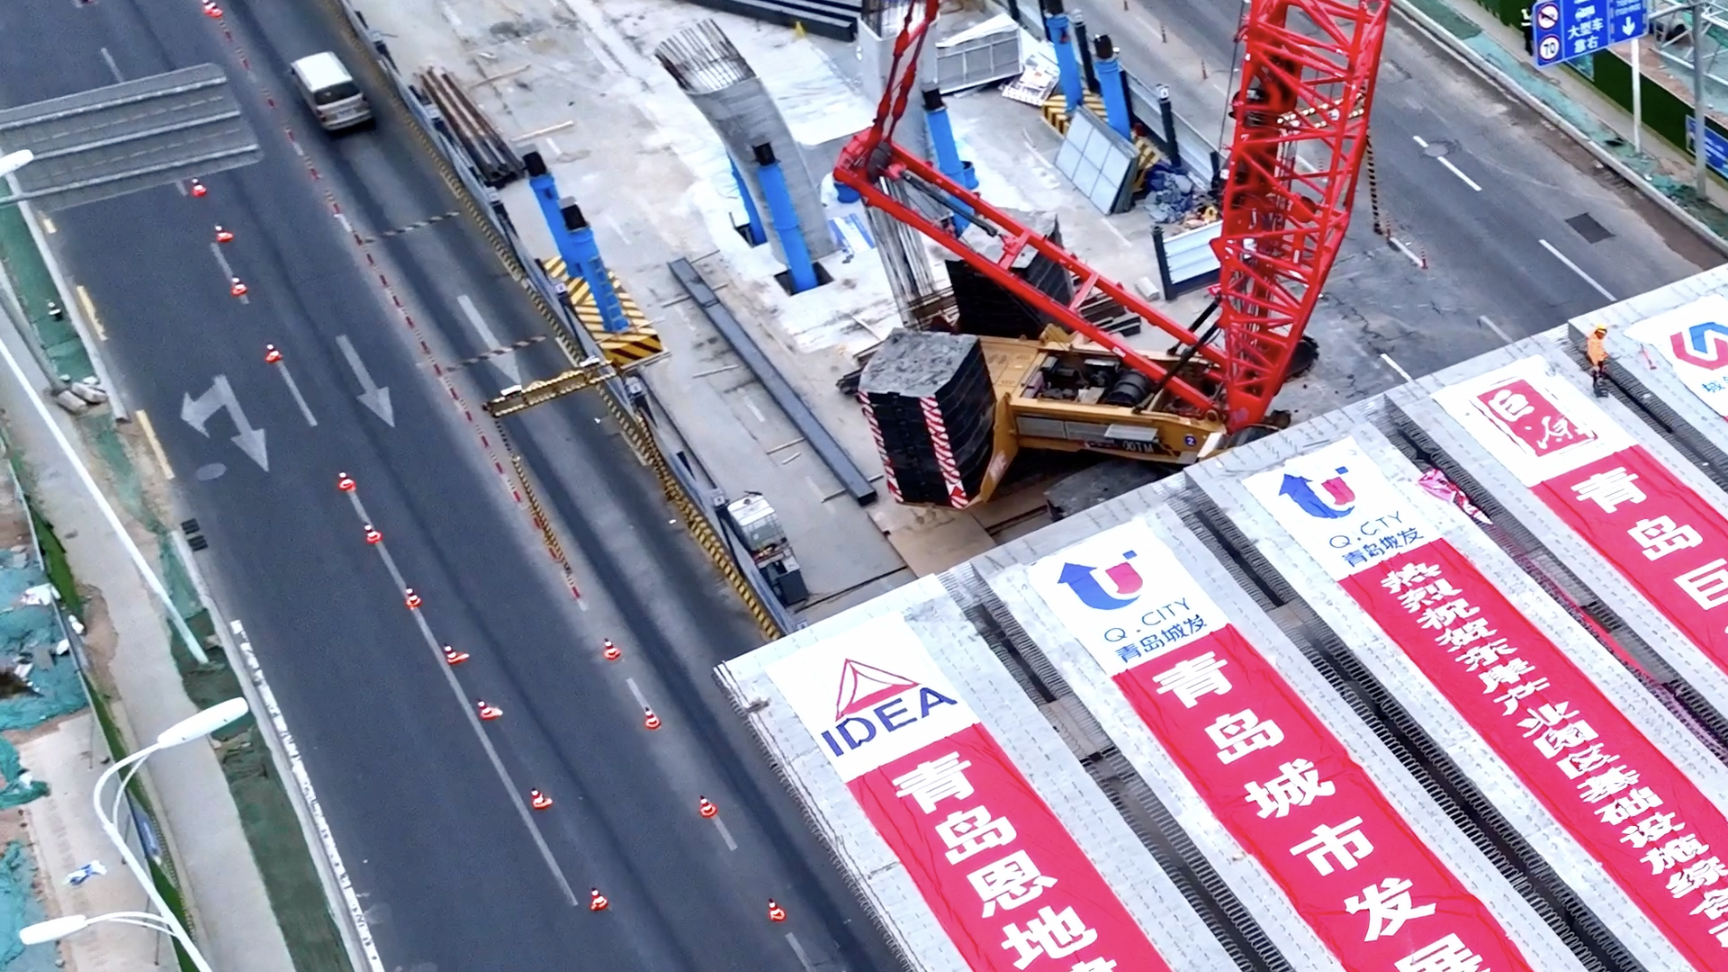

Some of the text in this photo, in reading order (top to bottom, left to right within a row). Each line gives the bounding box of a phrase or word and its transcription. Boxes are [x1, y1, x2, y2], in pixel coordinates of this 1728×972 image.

[1543, 42, 1556, 56] 70
[1342, 527, 1424, 567] 青岛城发
[1115, 614, 1207, 663] 青岛城发
[820, 686, 958, 758] IDEA
